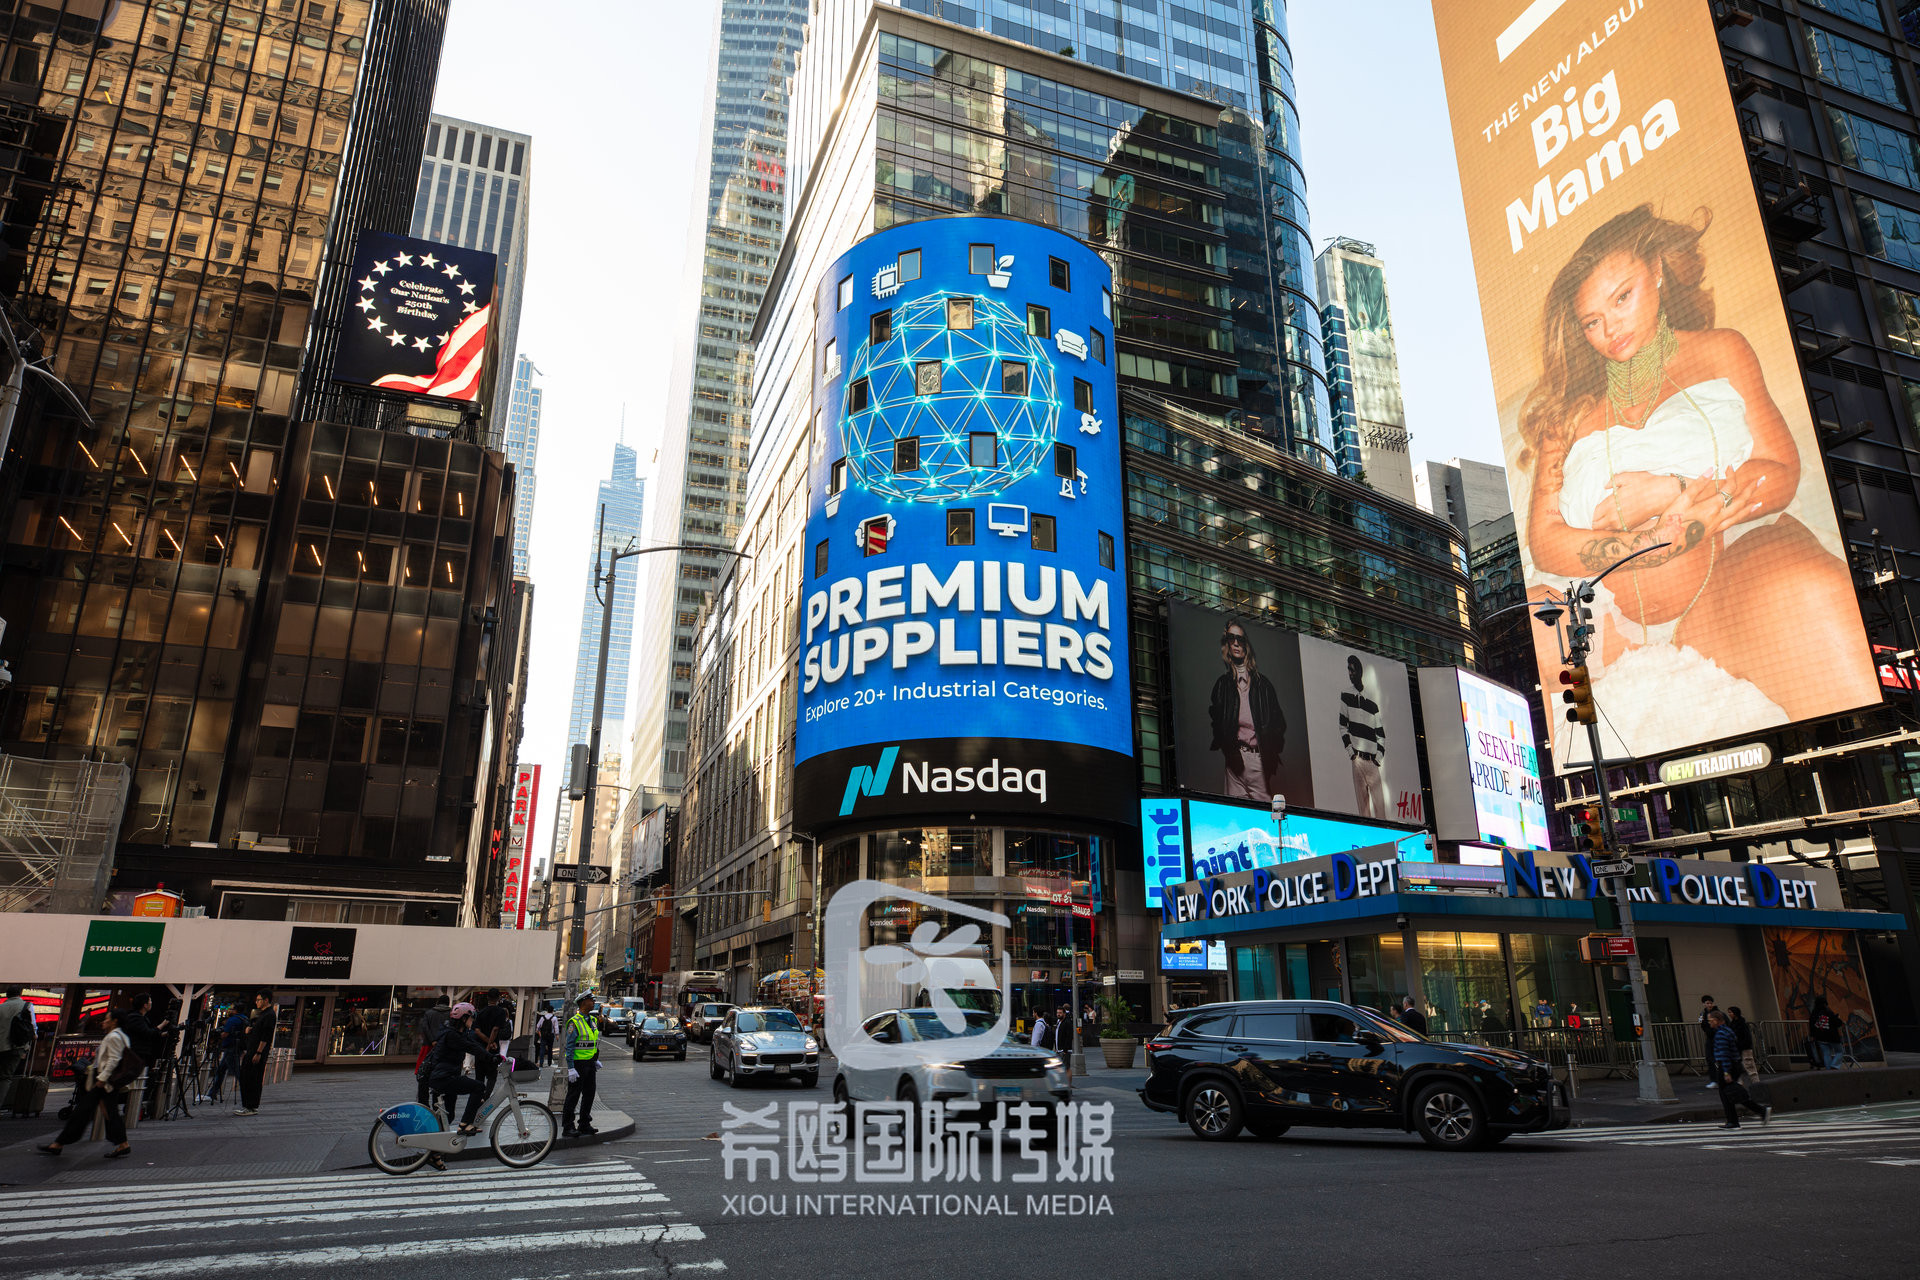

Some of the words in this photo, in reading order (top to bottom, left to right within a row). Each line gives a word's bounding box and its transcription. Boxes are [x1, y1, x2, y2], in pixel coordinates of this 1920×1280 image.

[1482, 102, 1520, 143] THE
[1522, 54, 1571, 110] NEW
[1576, 0, 1645, 64] ALBU
[1530, 69, 1621, 169] Big
[1505, 98, 1680, 254] Mama
[390, 287, 410, 296] Our
[411, 291, 450, 304] Nation's
[399, 280, 444, 294] Celebrate
[405, 300, 432, 310] 250th
[396, 306, 438, 320] Birthday
[806, 560, 1110, 646] PREMIUM
[803, 618, 1115, 694] SUPPLIERS
[806, 695, 849, 723] Explore
[854, 690, 886, 706] 20+
[893, 680, 996, 701] Industrial
[1004, 682, 1108, 711] Categories.
[513, 772, 531, 825] PARK
[902, 758, 1046, 804] Nasdaq
[1396, 790, 1422, 822] H&M
[561, 869, 578, 877] ONE
[1147, 808, 1182, 899] hint
[1192, 840, 1253, 880] hint
[1595, 865, 1609, 875] ONE
[1615, 863, 1629, 872] WAY
[504, 857, 521, 912] PARK
[1161, 884, 1200, 924] NEW
[1199, 878, 1251, 919] YORK
[1253, 868, 1325, 912] POLICE
[1331, 852, 1397, 900] DEPT
[1502, 848, 1575, 899] NEW
[1657, 858, 1749, 906] POLICE
[1750, 864, 1817, 909] DEPT
[1026, 906, 1047, 914] Nasdaq
[89, 945, 143, 953] STARBUCKS
